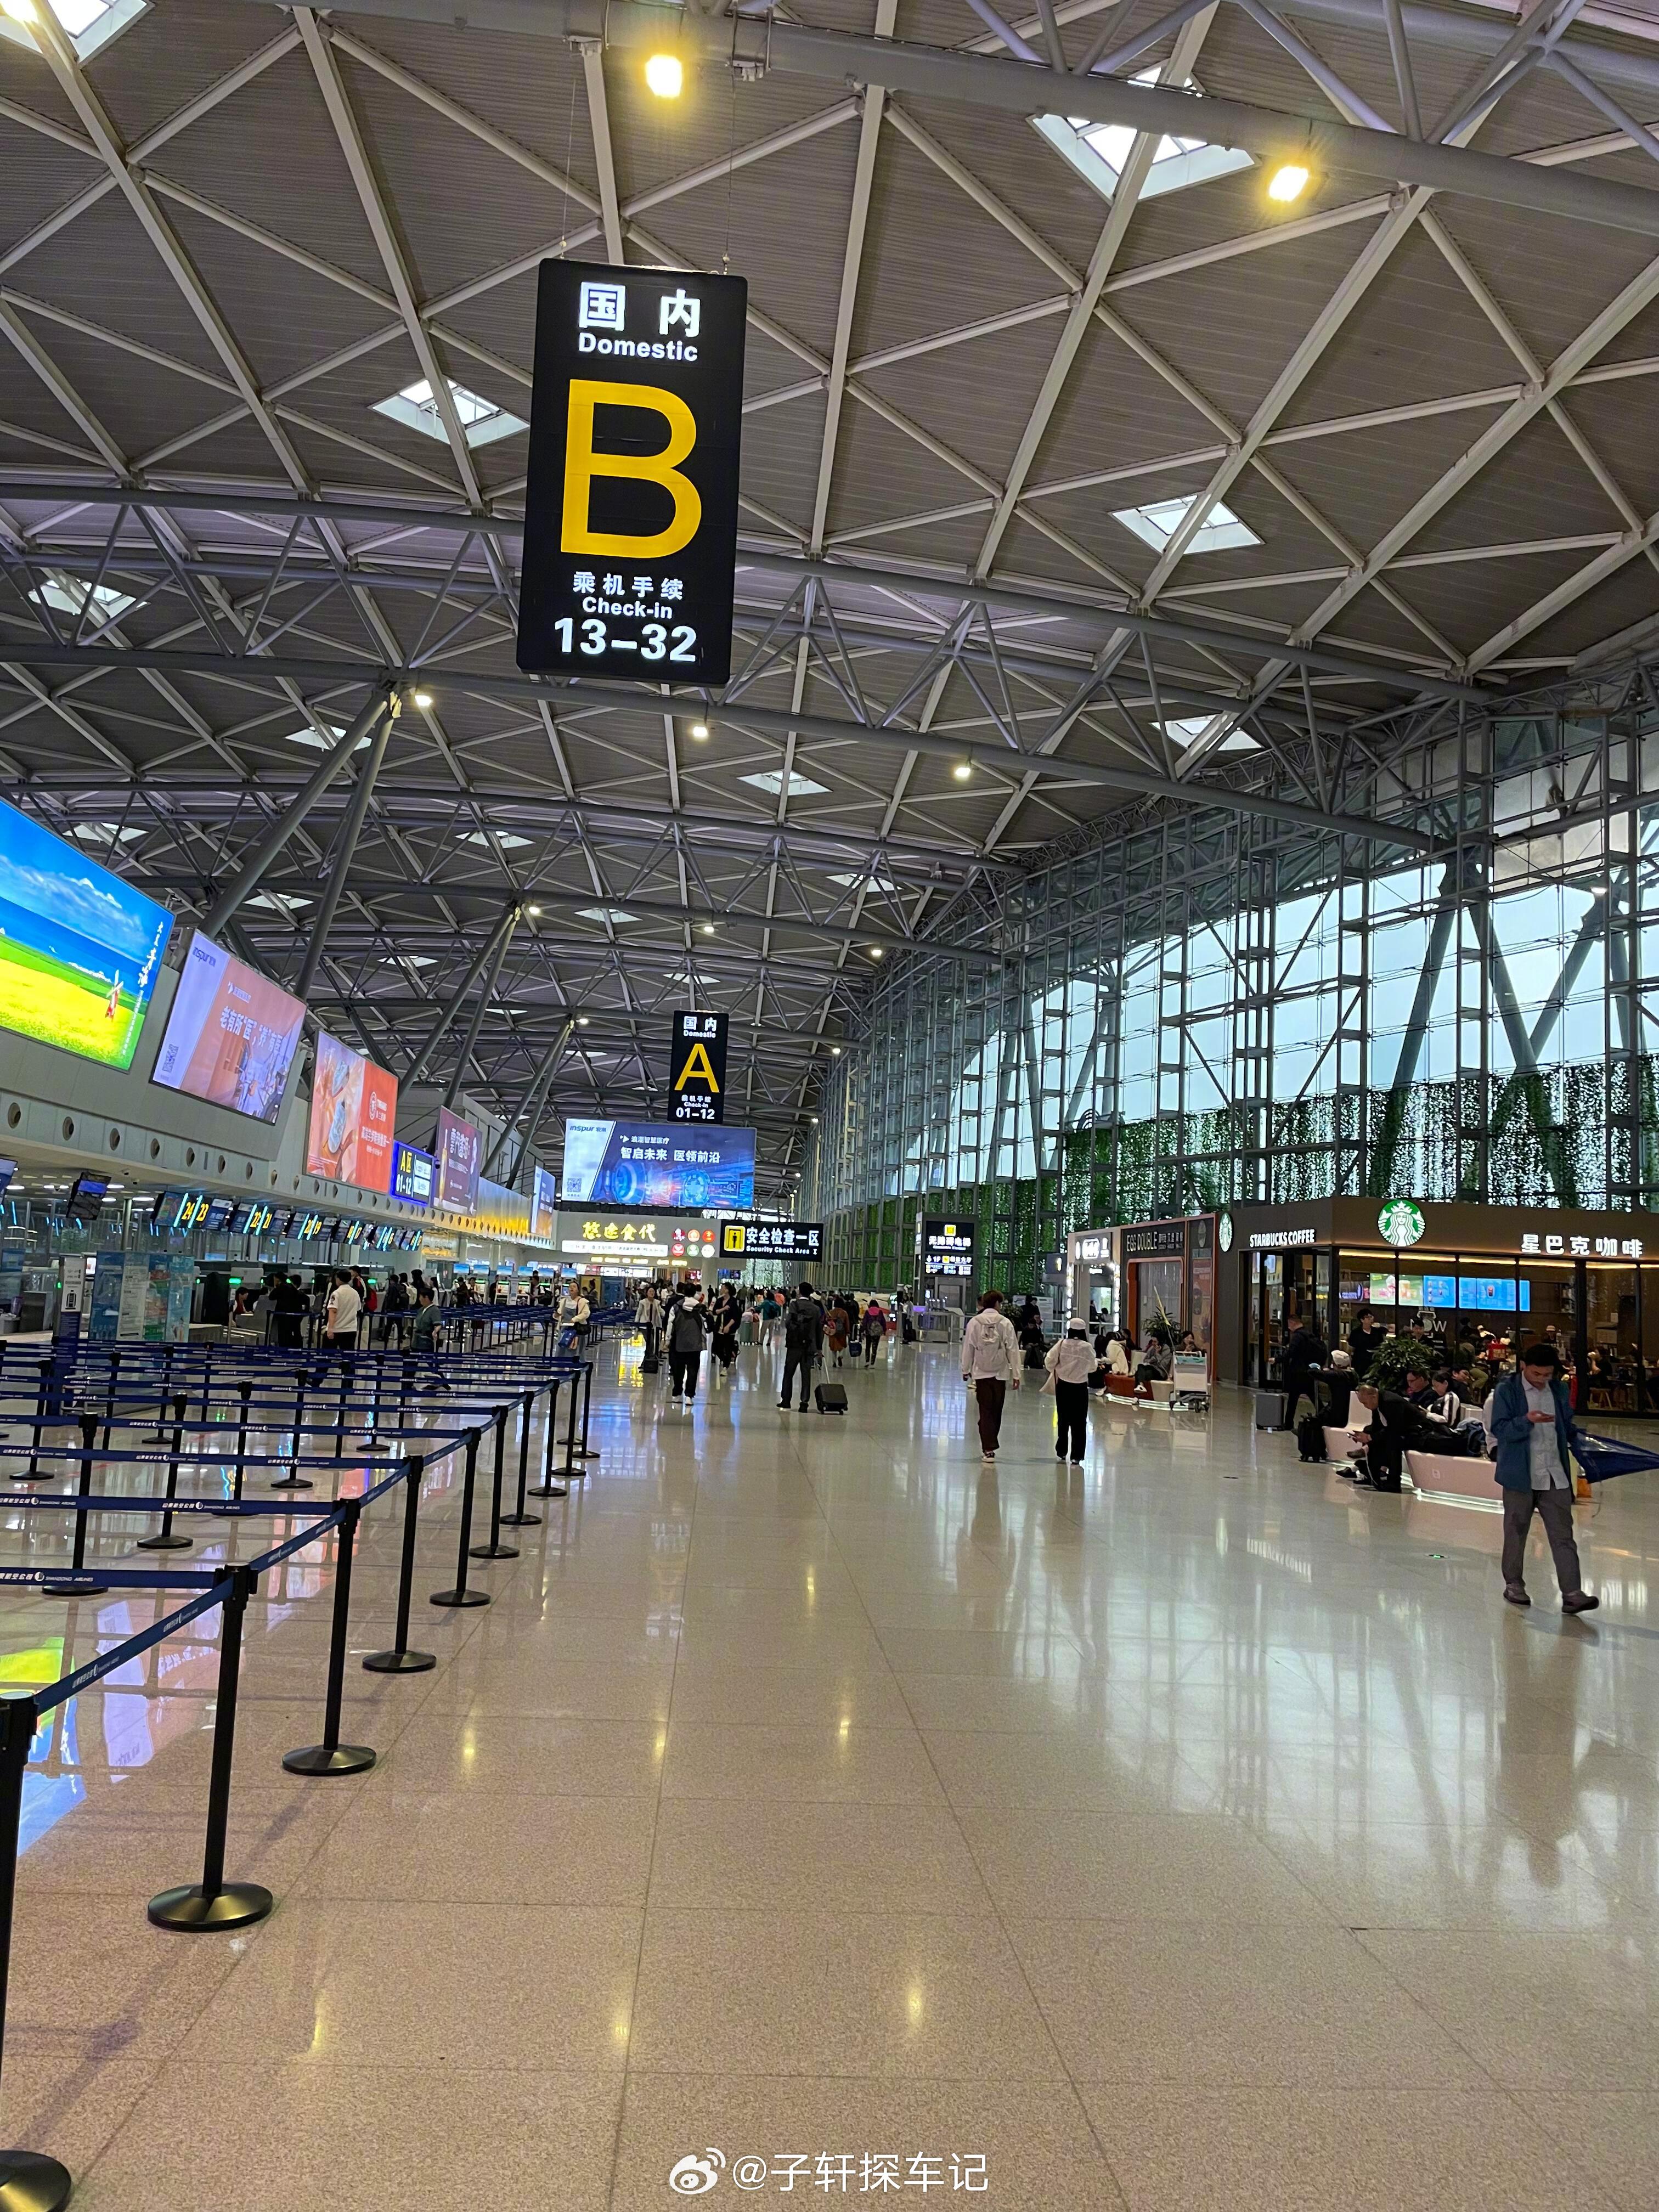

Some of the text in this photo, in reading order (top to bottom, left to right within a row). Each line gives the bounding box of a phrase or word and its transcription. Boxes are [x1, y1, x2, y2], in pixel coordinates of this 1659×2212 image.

[579, 281, 701, 337] 国内
[578, 332, 698, 362] Domestic
[560, 379, 702, 559] B
[572, 571, 684, 601] 乘机手续
[582, 596, 673, 619] Check-in
[683, 1030, 716, 1038] Domestic
[684, 1015, 717, 1032] 国内
[674, 1043, 720, 1093] A
[620, 1146, 721, 1164] 智启未来 医领前沿
[746, 1226, 819, 1246] 安全检查一区
[1250, 1229, 1315, 1248] STARBUCKS COFFEE
[1521, 1234, 1643, 1259] 星巴克咖啡
[746, 1245, 773, 1254] Security
